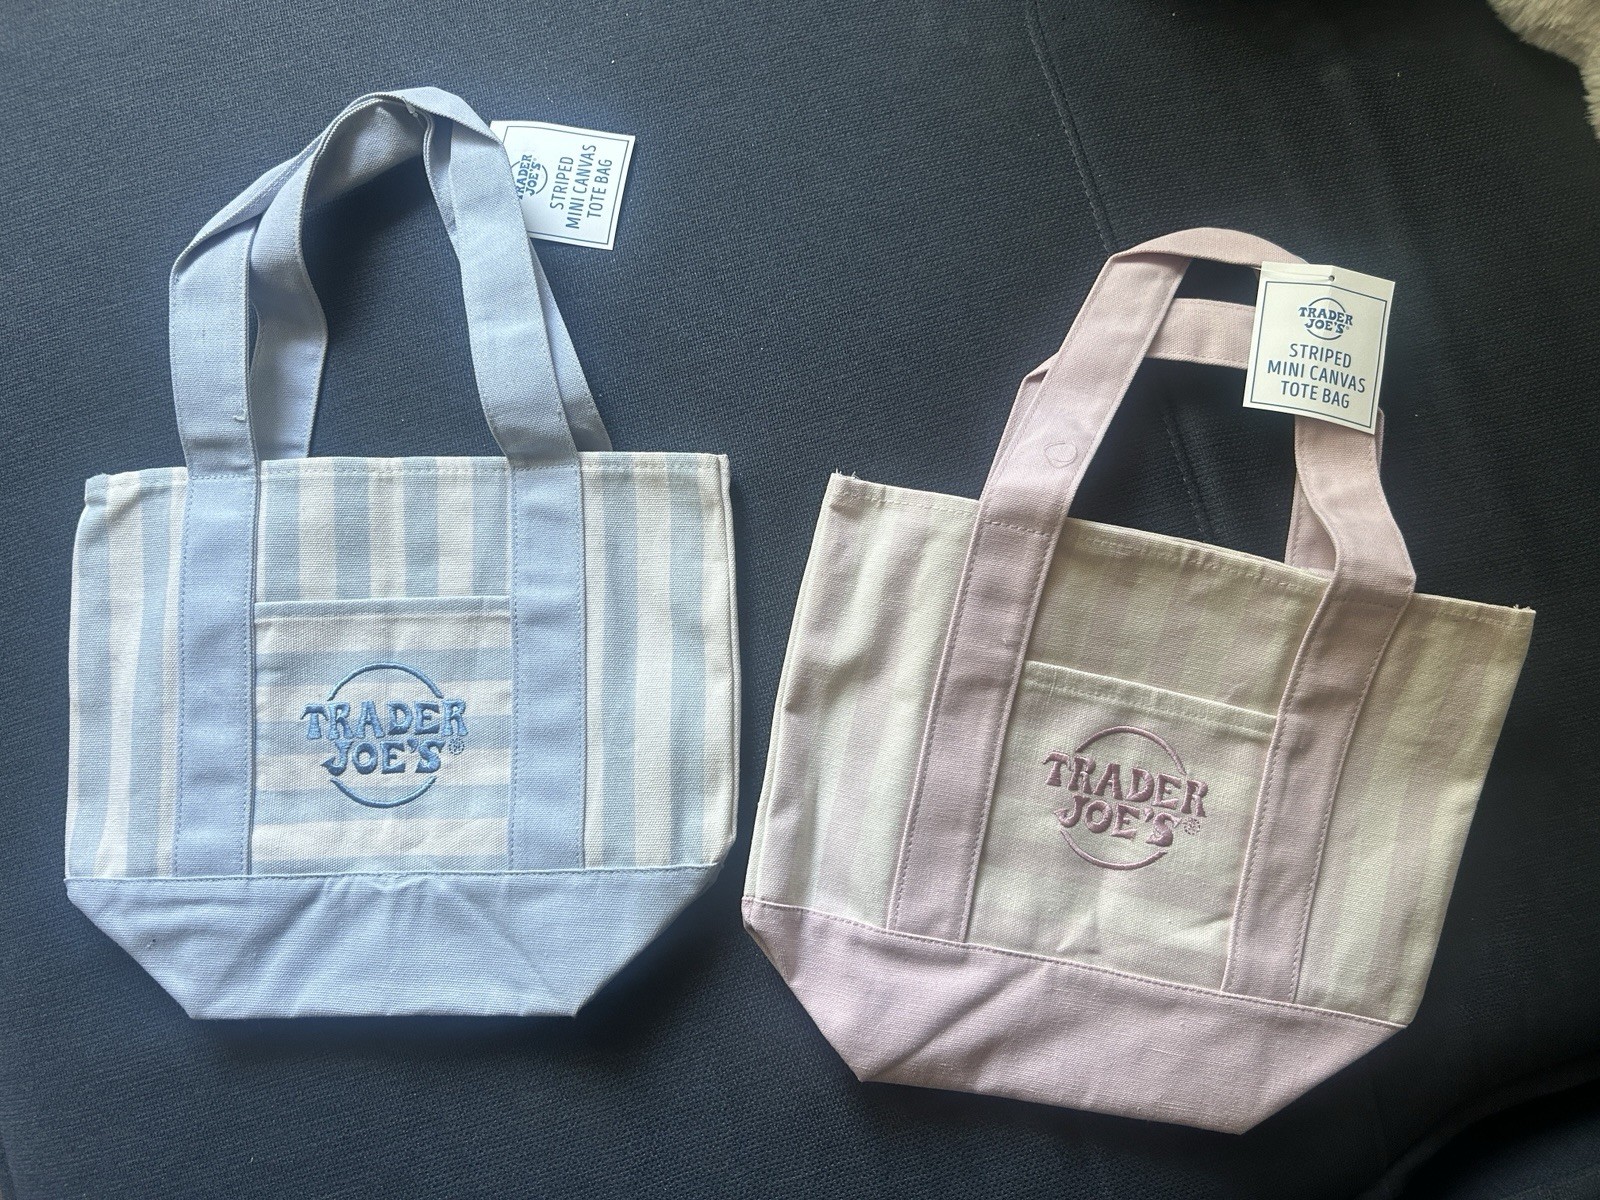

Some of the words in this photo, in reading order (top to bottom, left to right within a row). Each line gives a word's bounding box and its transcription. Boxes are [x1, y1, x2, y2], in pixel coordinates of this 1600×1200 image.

[550, 156, 574, 210] STRIPED
[573, 144, 597, 194] CANVAS
[594, 159, 613, 184] BAG
[565, 197, 585, 229] MINI
[587, 187, 607, 218] TOTE
[1298, 306, 1353, 326] TRADER
[1289, 343, 1352, 369] STRIPED
[1267, 359, 1305, 378] MINI
[1309, 365, 1366, 393] CANVAS
[1281, 380, 1319, 400] TOTE
[1322, 388, 1350, 409] BAG
[300, 700, 469, 740] TRADER
[1041, 751, 1209, 818] TRADER
